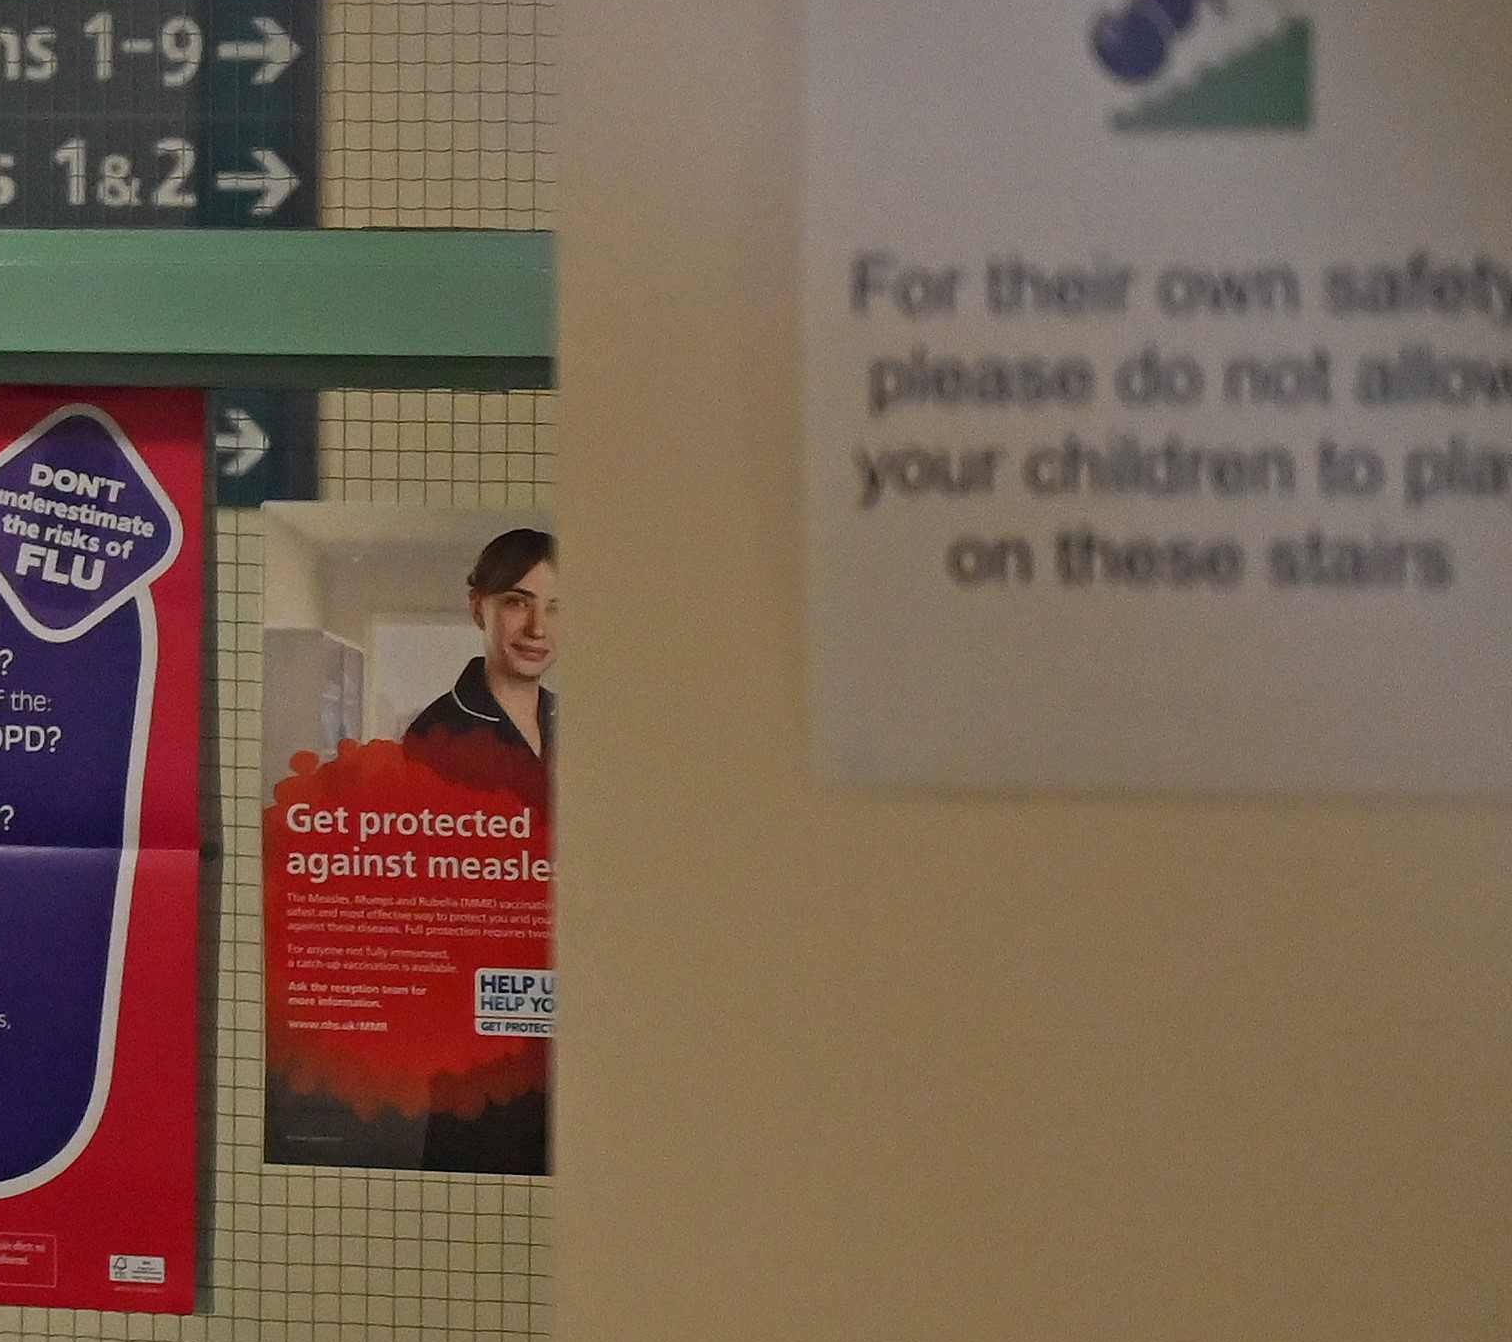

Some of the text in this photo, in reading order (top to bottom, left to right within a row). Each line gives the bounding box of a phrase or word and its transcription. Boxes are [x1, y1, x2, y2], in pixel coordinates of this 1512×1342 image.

[84, 12, 202, 84] 1-9
[55, 136, 197, 209] 1&2
[851, 253, 960, 316] For
[987, 257, 1131, 315] their
[1158, 266, 1302, 316] own
[869, 343, 1097, 416] please
[1115, 343, 1204, 405] do
[1223, 347, 1332, 405] not
[29, 463, 126, 503] DON'T
[855, 443, 1001, 509] your
[1024, 433, 1294, 496] children
[1318, 437, 1385, 497] to
[2, 513, 134, 559] the risks of
[946, 523, 1454, 588] on these stairs
[16, 543, 105, 590] FLU
[10, 690, 52, 712] the:
[286, 803, 531, 842] Get protected
[286, 846, 553, 883] against measle
[287, 892, 307, 903] The
[288, 981, 308, 992] Ask
[310, 982, 327, 992] the
[330, 983, 379, 996] reception
[411, 986, 427, 996] for
[288, 997, 315, 1006] more
[481, 975, 535, 994] HELP
[481, 995, 524, 1011] HELP
[481, 1022, 501, 1031] GET
